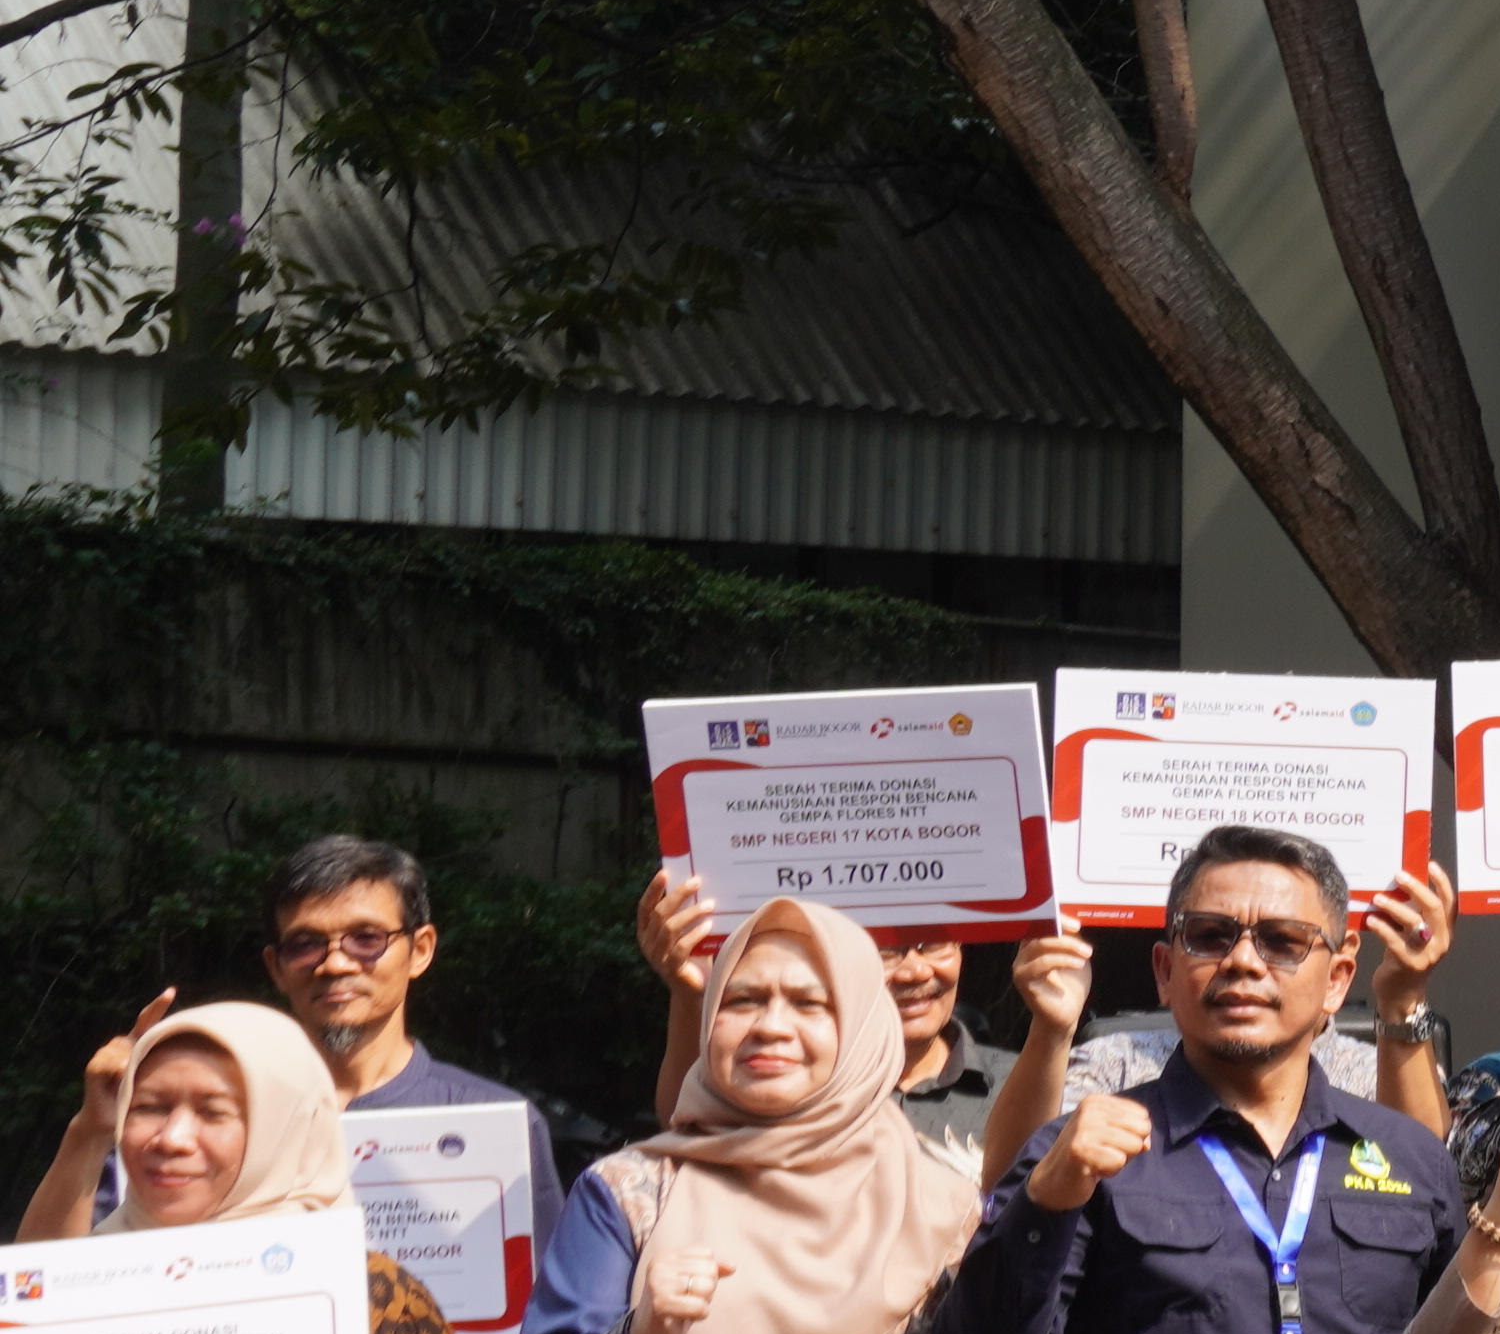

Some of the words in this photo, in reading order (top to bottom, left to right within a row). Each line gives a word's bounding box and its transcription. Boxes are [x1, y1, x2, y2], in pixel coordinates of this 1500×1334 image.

[1121, 805, 1157, 819] SMP
[1162, 808, 1225, 822] NEGERI
[1230, 809, 1248, 823] 18
[1252, 810, 1298, 824] KOTA
[1303, 811, 1365, 826] BOGOR
